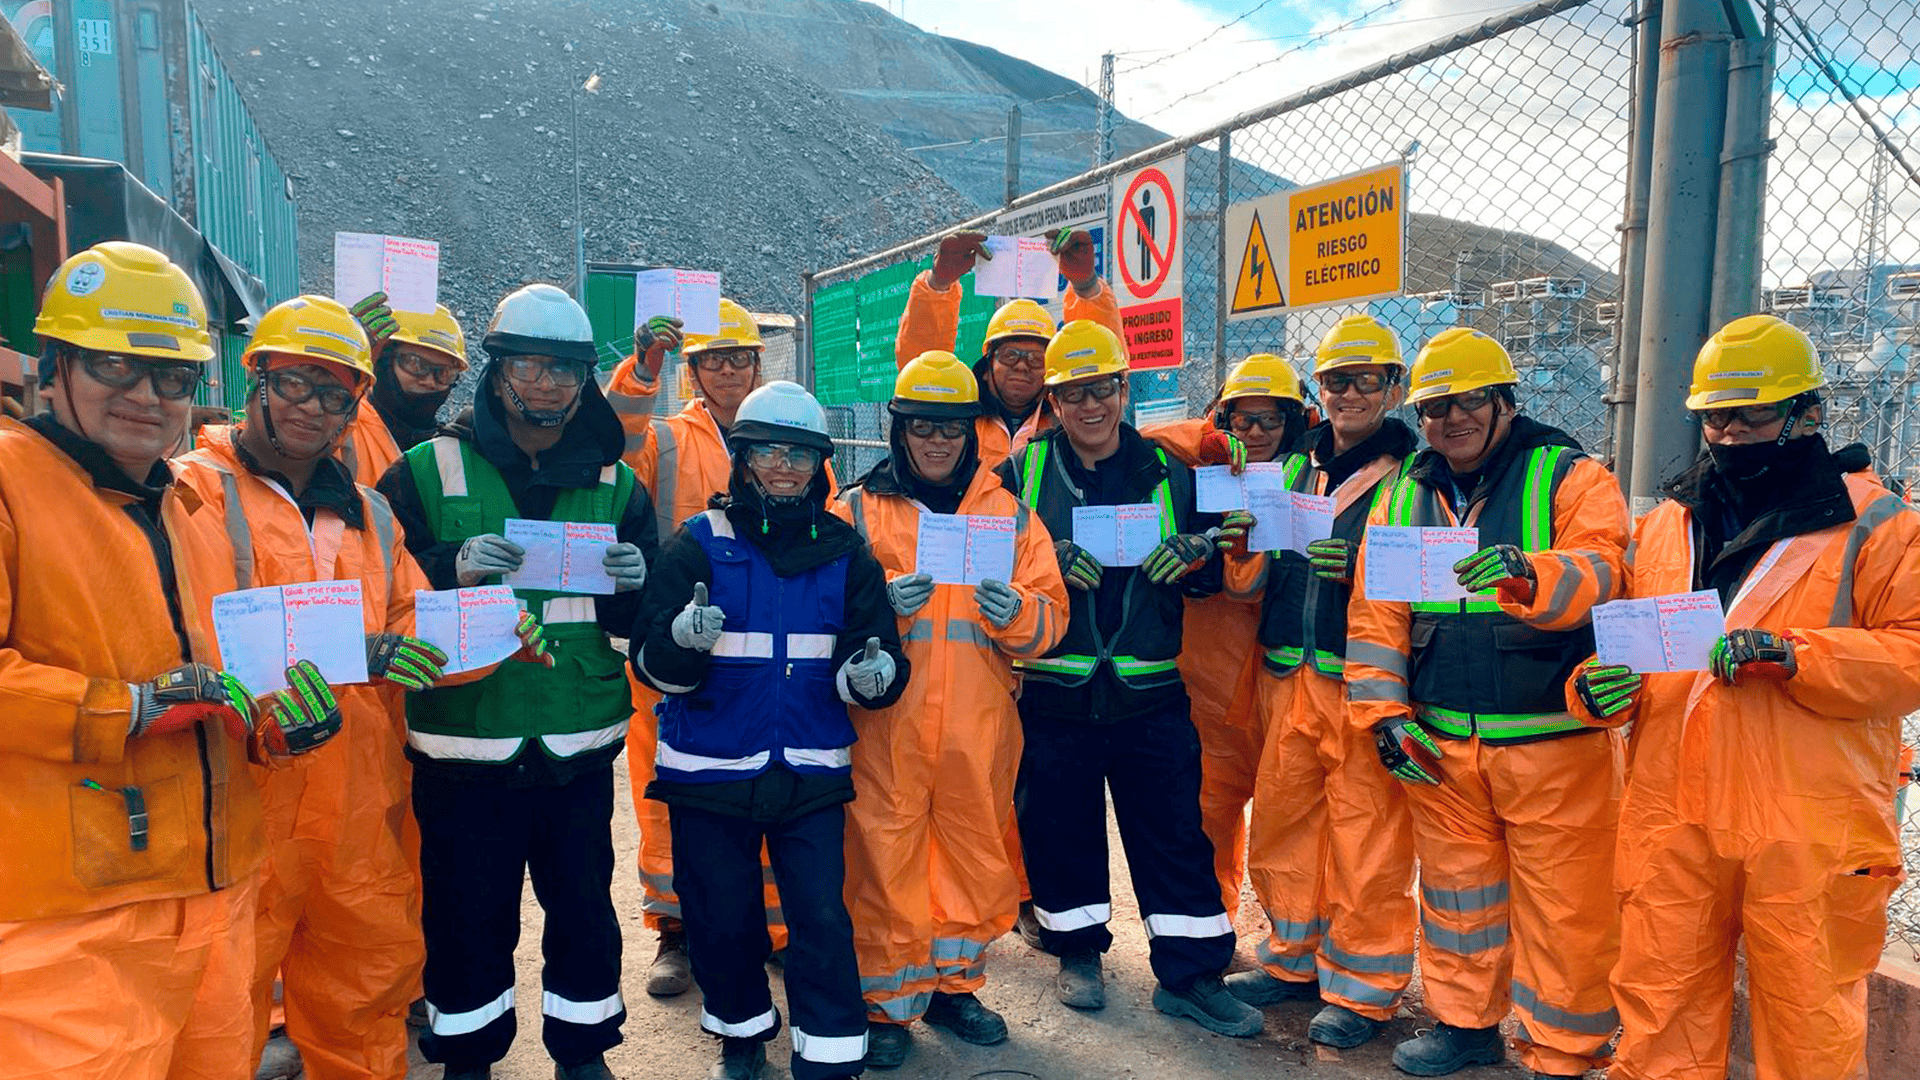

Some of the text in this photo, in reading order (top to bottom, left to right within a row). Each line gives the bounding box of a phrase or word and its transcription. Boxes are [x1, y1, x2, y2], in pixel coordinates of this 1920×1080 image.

[80, 21, 108, 36] 411
[81, 36, 109, 51] 351
[1045, 203, 1069, 225] PERSONAL
[1070, 192, 1106, 219] OBLIGATORIOS
[1296, 184, 1394, 233] ATENCIÓN
[1317, 233, 1367, 259] RIESGO
[1305, 257, 1381, 286] ELÉCTRICO
[1122, 310, 1171, 329] PROHIBIDO
[1134, 329, 1174, 346] INGRESO
